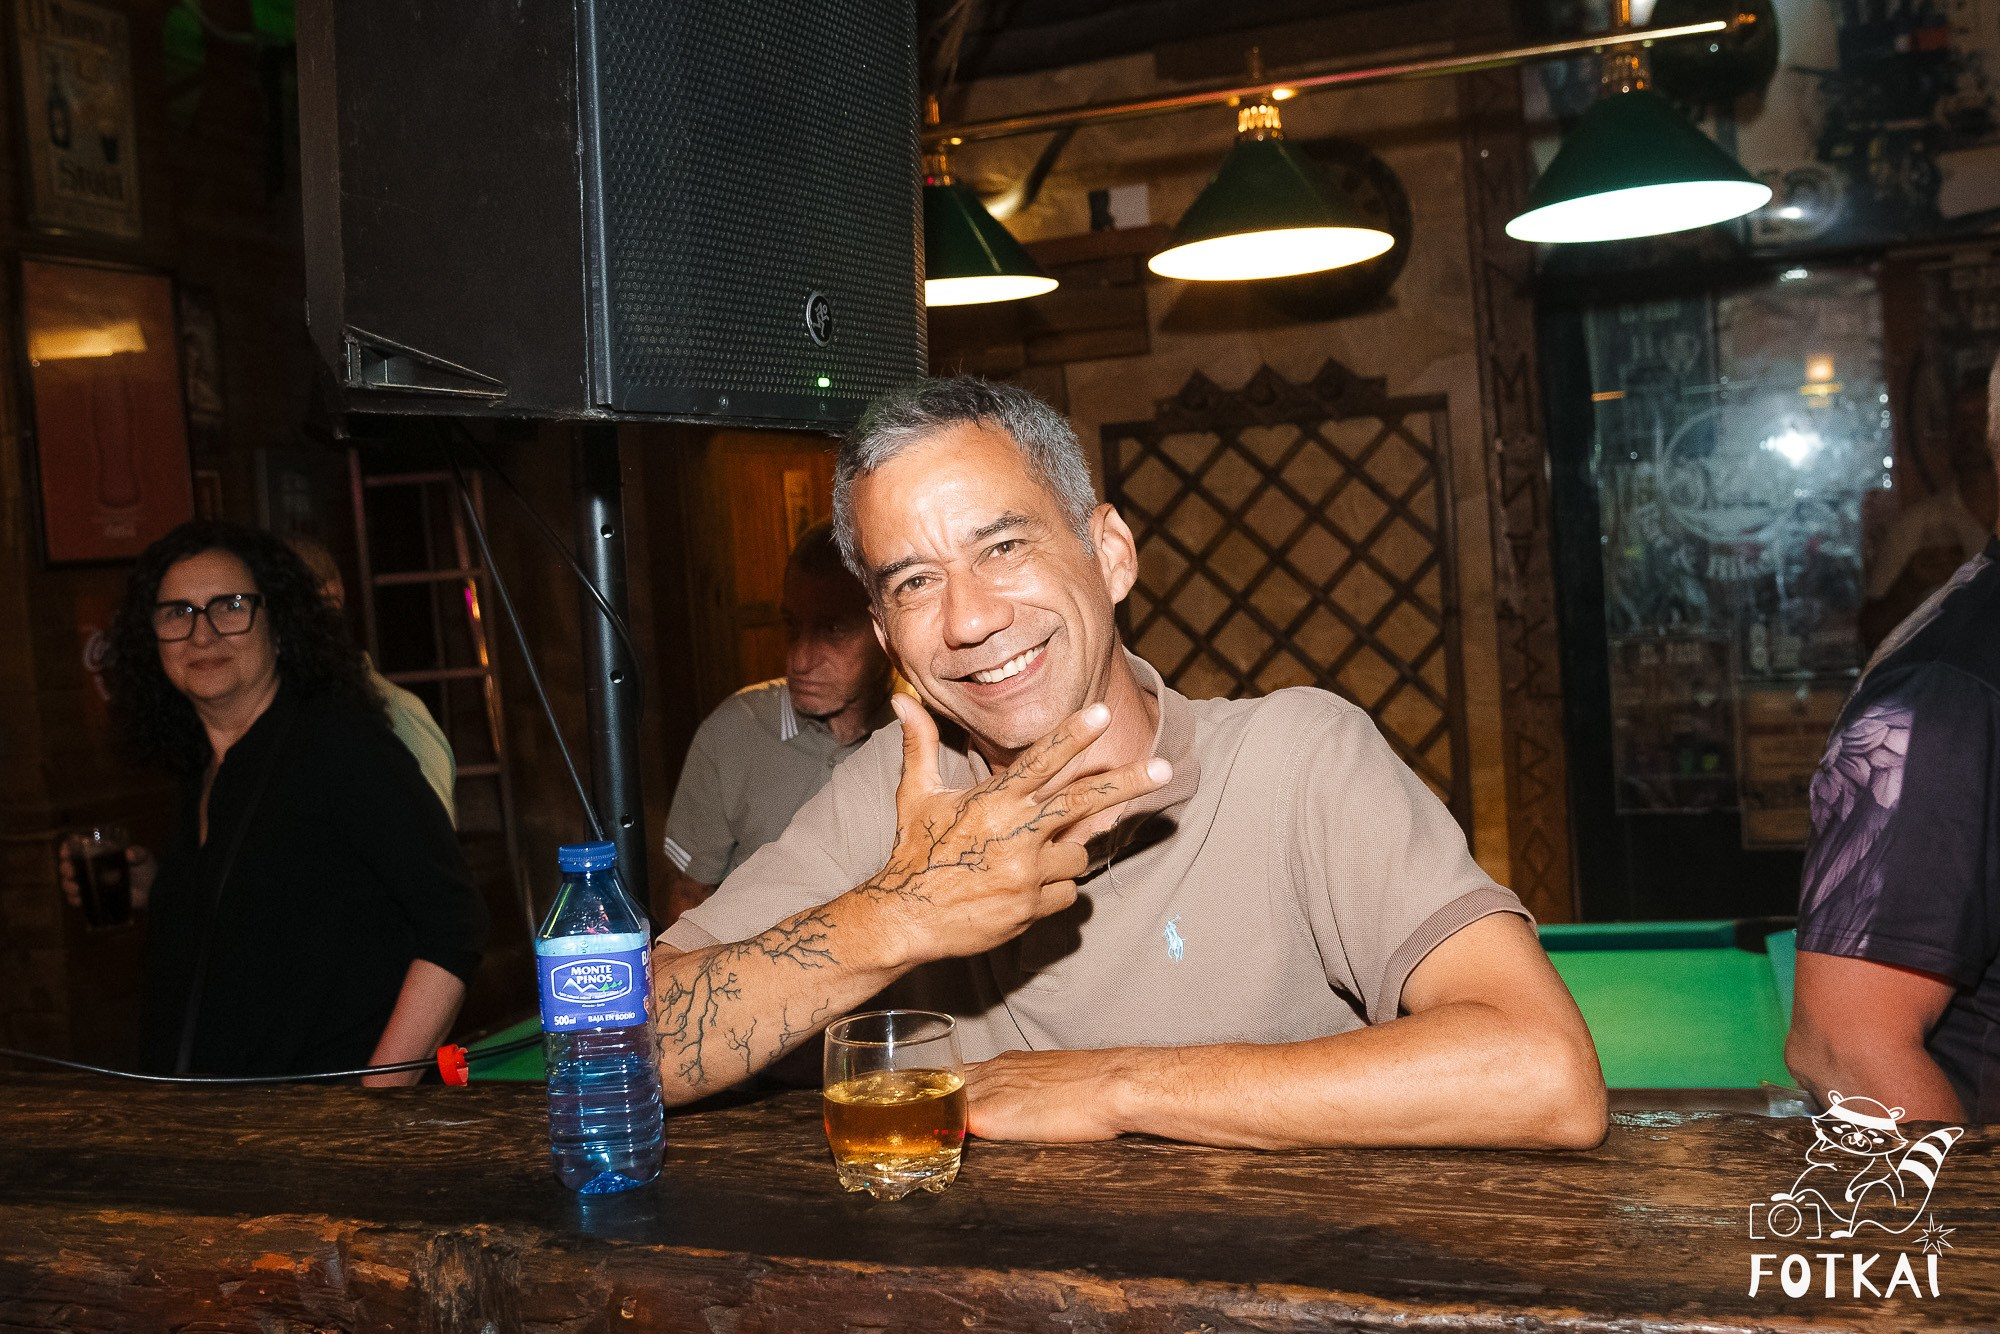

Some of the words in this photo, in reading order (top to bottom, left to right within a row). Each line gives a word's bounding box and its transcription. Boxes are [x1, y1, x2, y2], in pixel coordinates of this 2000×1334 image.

[571, 965, 612, 976] MONTE
[576, 974, 613, 984] PINOS
[588, 1015, 604, 1023] BAJA
